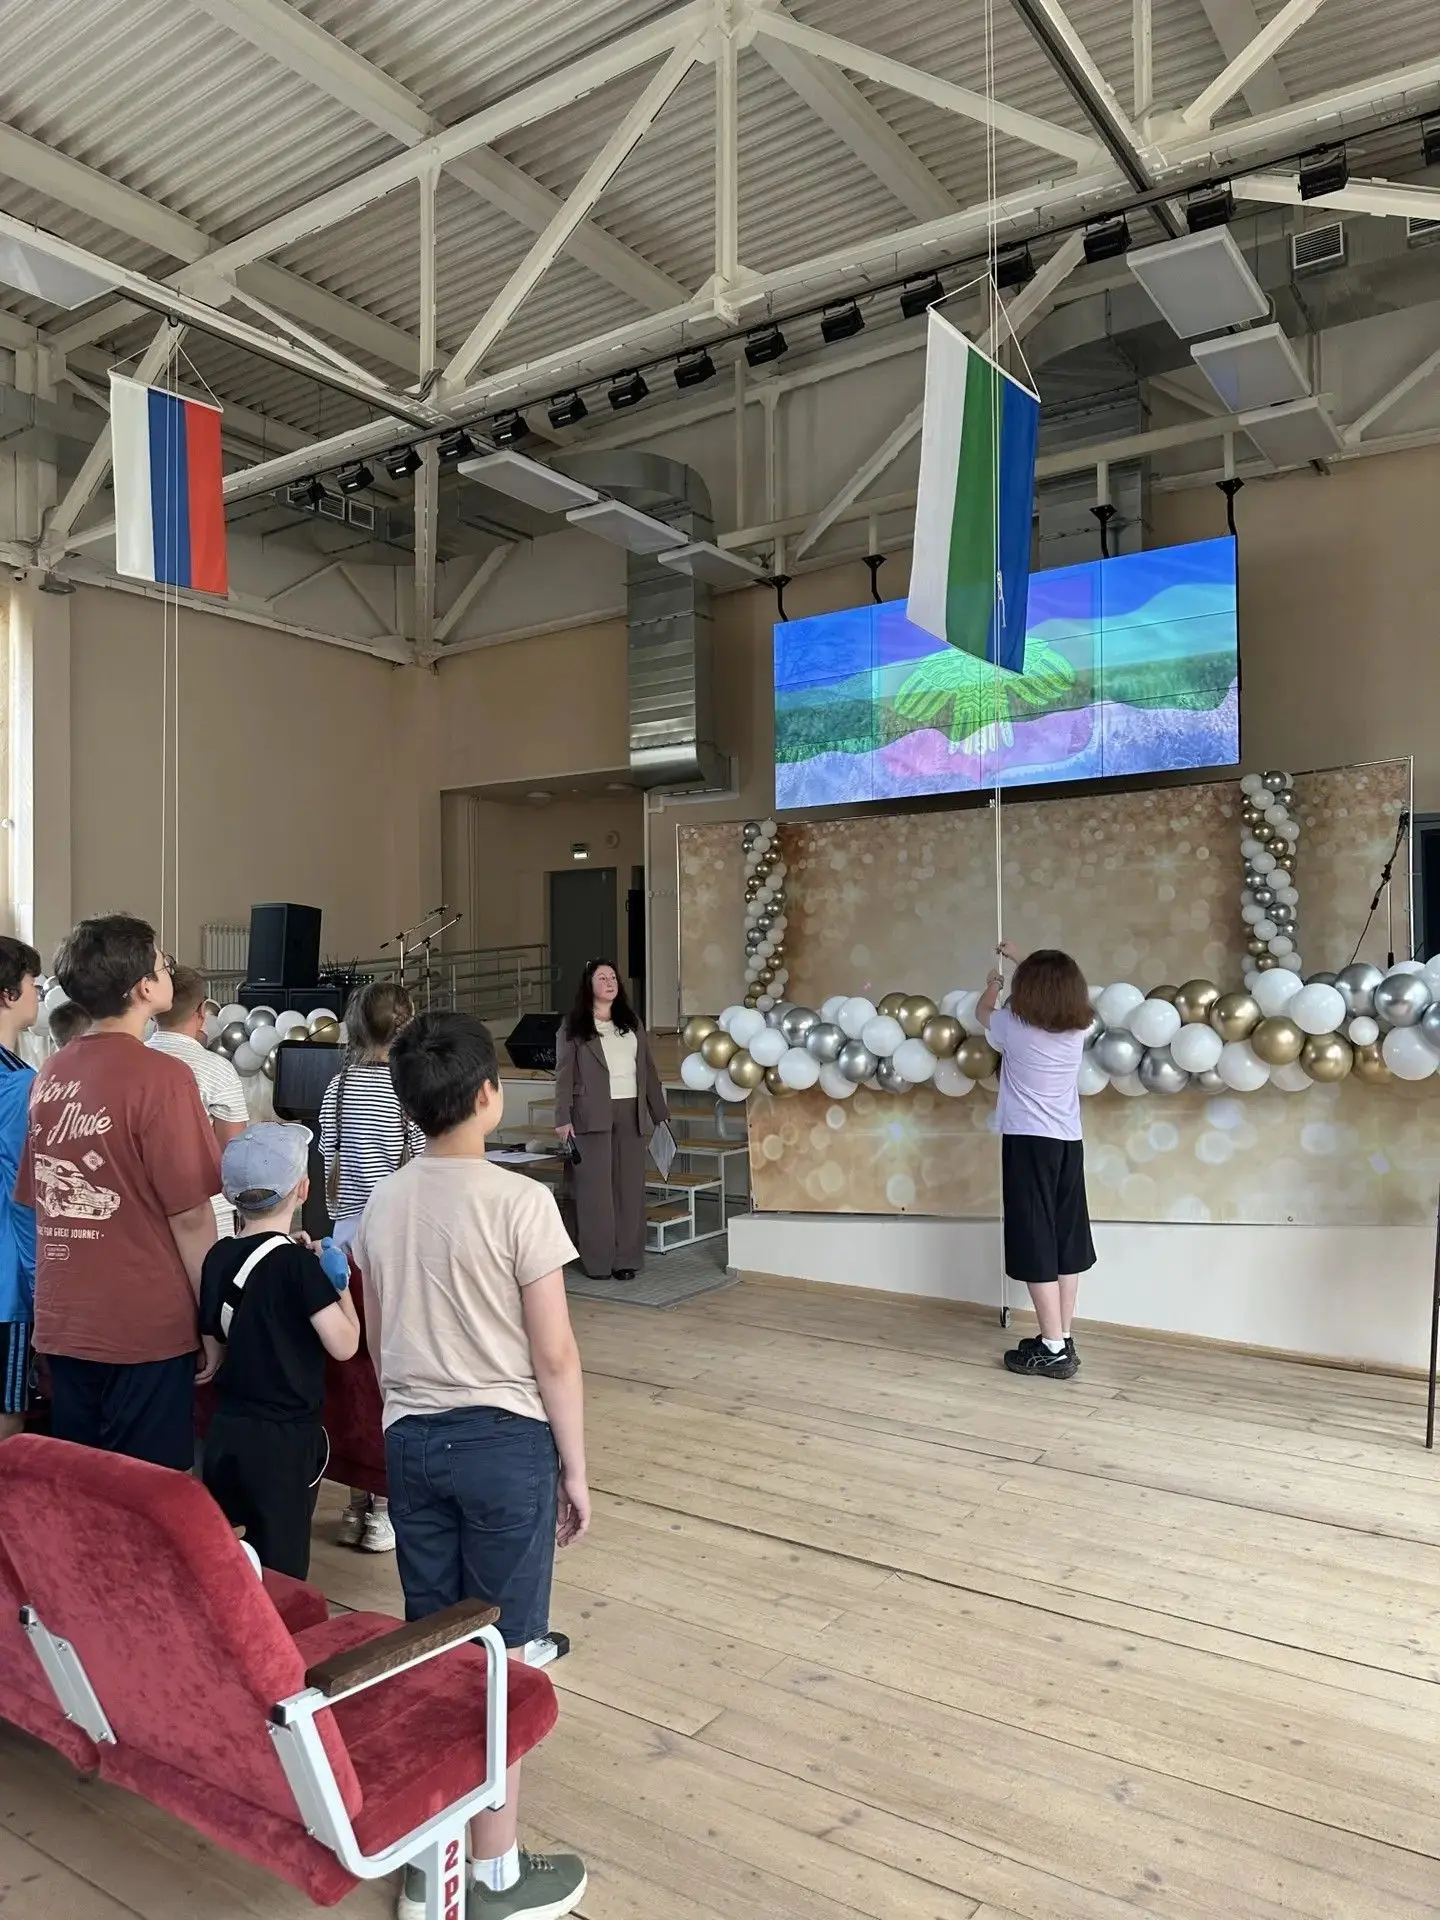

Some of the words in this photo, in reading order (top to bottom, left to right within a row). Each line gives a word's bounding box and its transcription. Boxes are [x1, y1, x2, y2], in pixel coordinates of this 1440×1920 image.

[46, 1102, 113, 1147] Made
[54, 1228, 70, 1237] GREAT
[71, 1229, 100, 1240] JOURNEY
